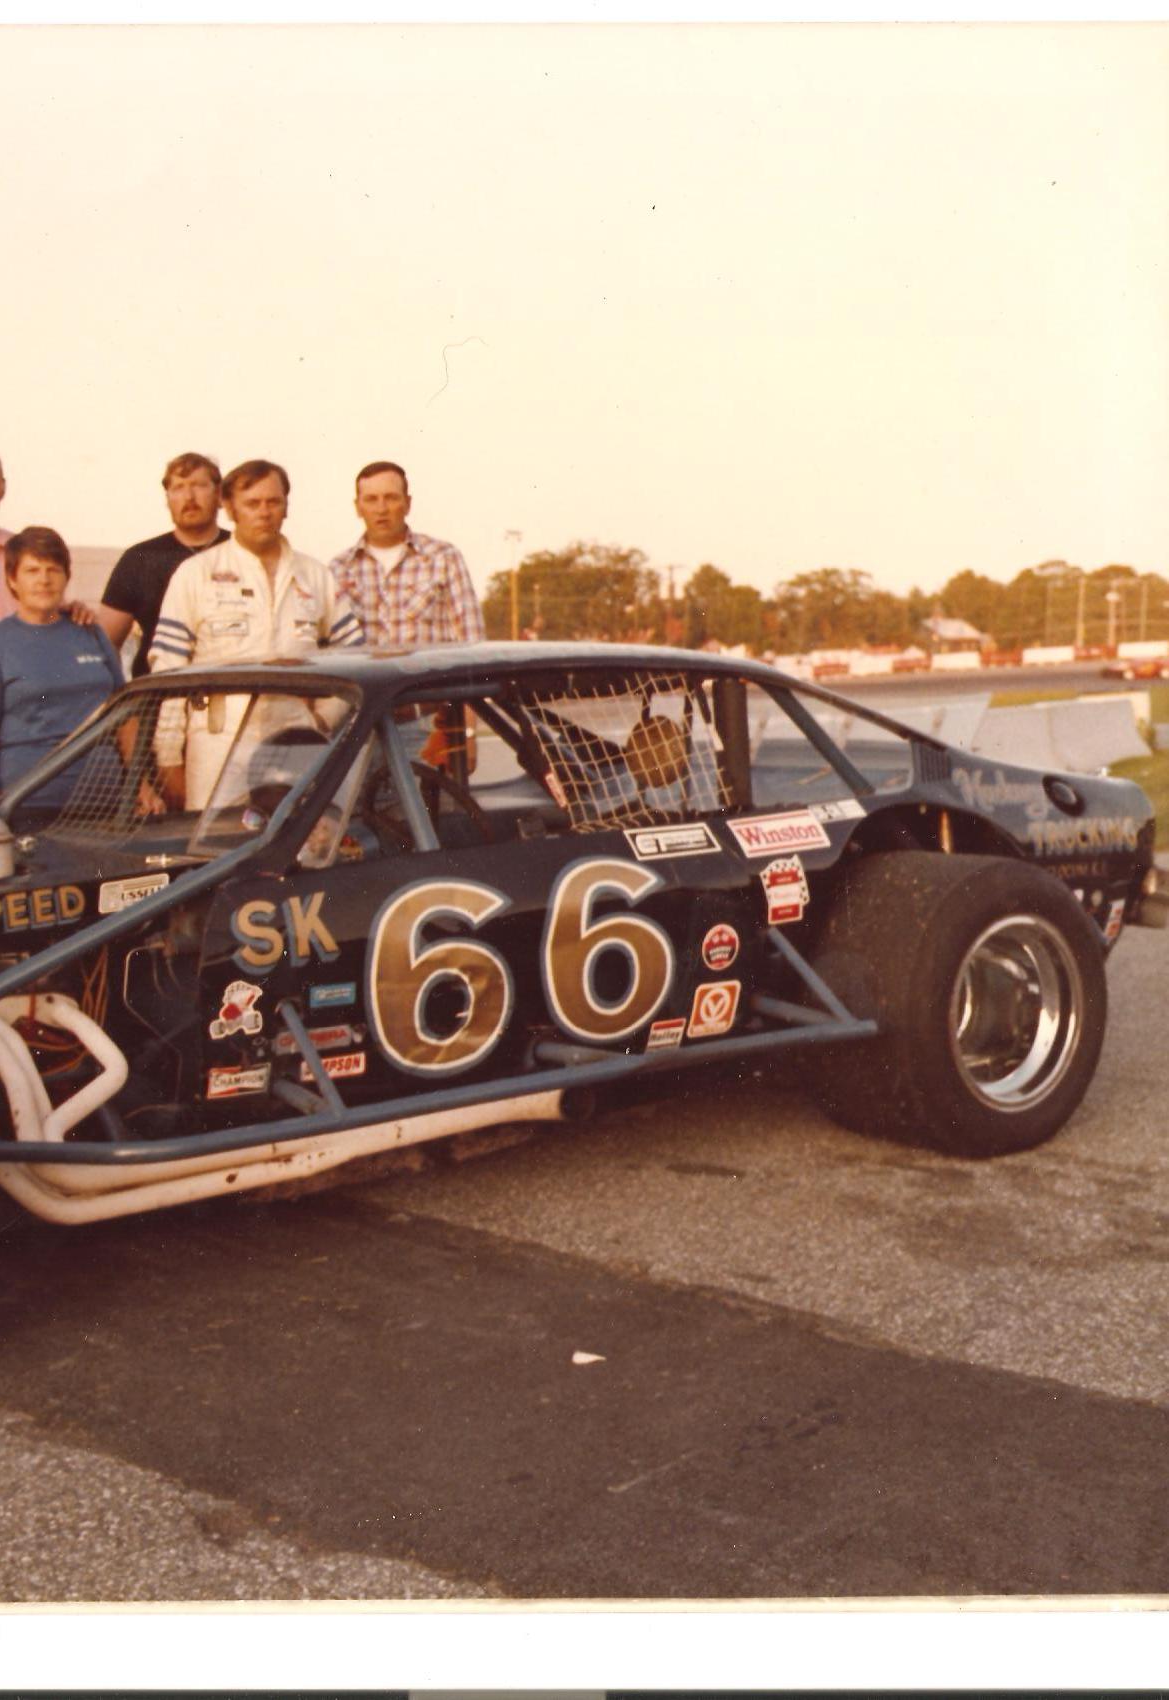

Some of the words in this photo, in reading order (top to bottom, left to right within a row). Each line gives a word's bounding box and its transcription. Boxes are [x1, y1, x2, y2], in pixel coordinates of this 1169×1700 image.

[737, 823, 821, 848] Winston
[233, 891, 339, 973] SK
[367, 856, 674, 1075] 66
